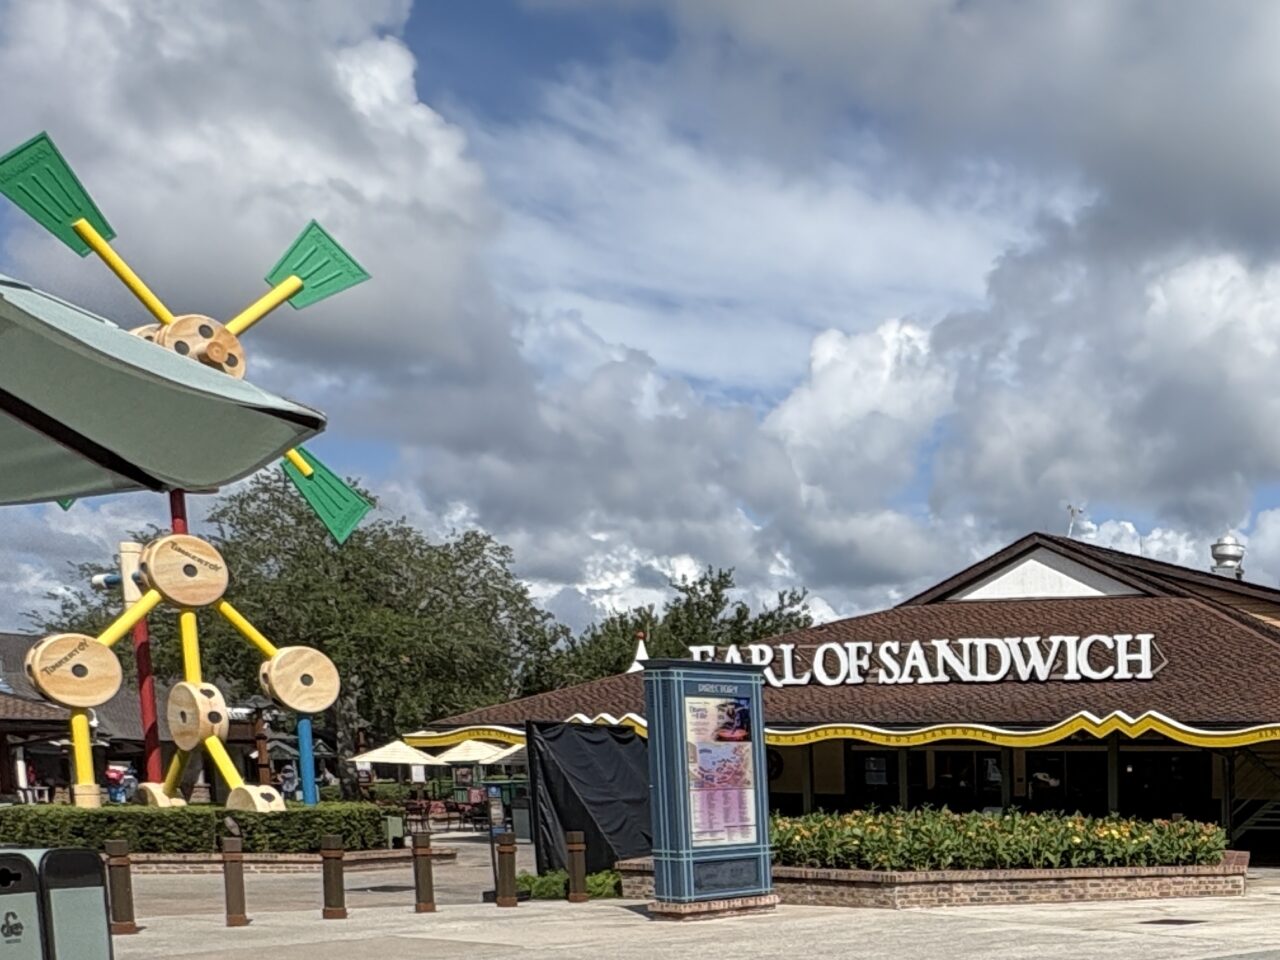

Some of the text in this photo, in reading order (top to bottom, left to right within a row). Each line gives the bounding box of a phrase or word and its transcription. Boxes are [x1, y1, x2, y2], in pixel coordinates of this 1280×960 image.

[40, 638, 89, 676] TINKERTOY
[812, 640, 873, 686] OF
[878, 633, 1155, 685] SANDWICH
[697, 683, 739, 694] DIRECTORY
[885, 735, 912, 743] HOT
[922, 728, 998, 741] SANDWICH
